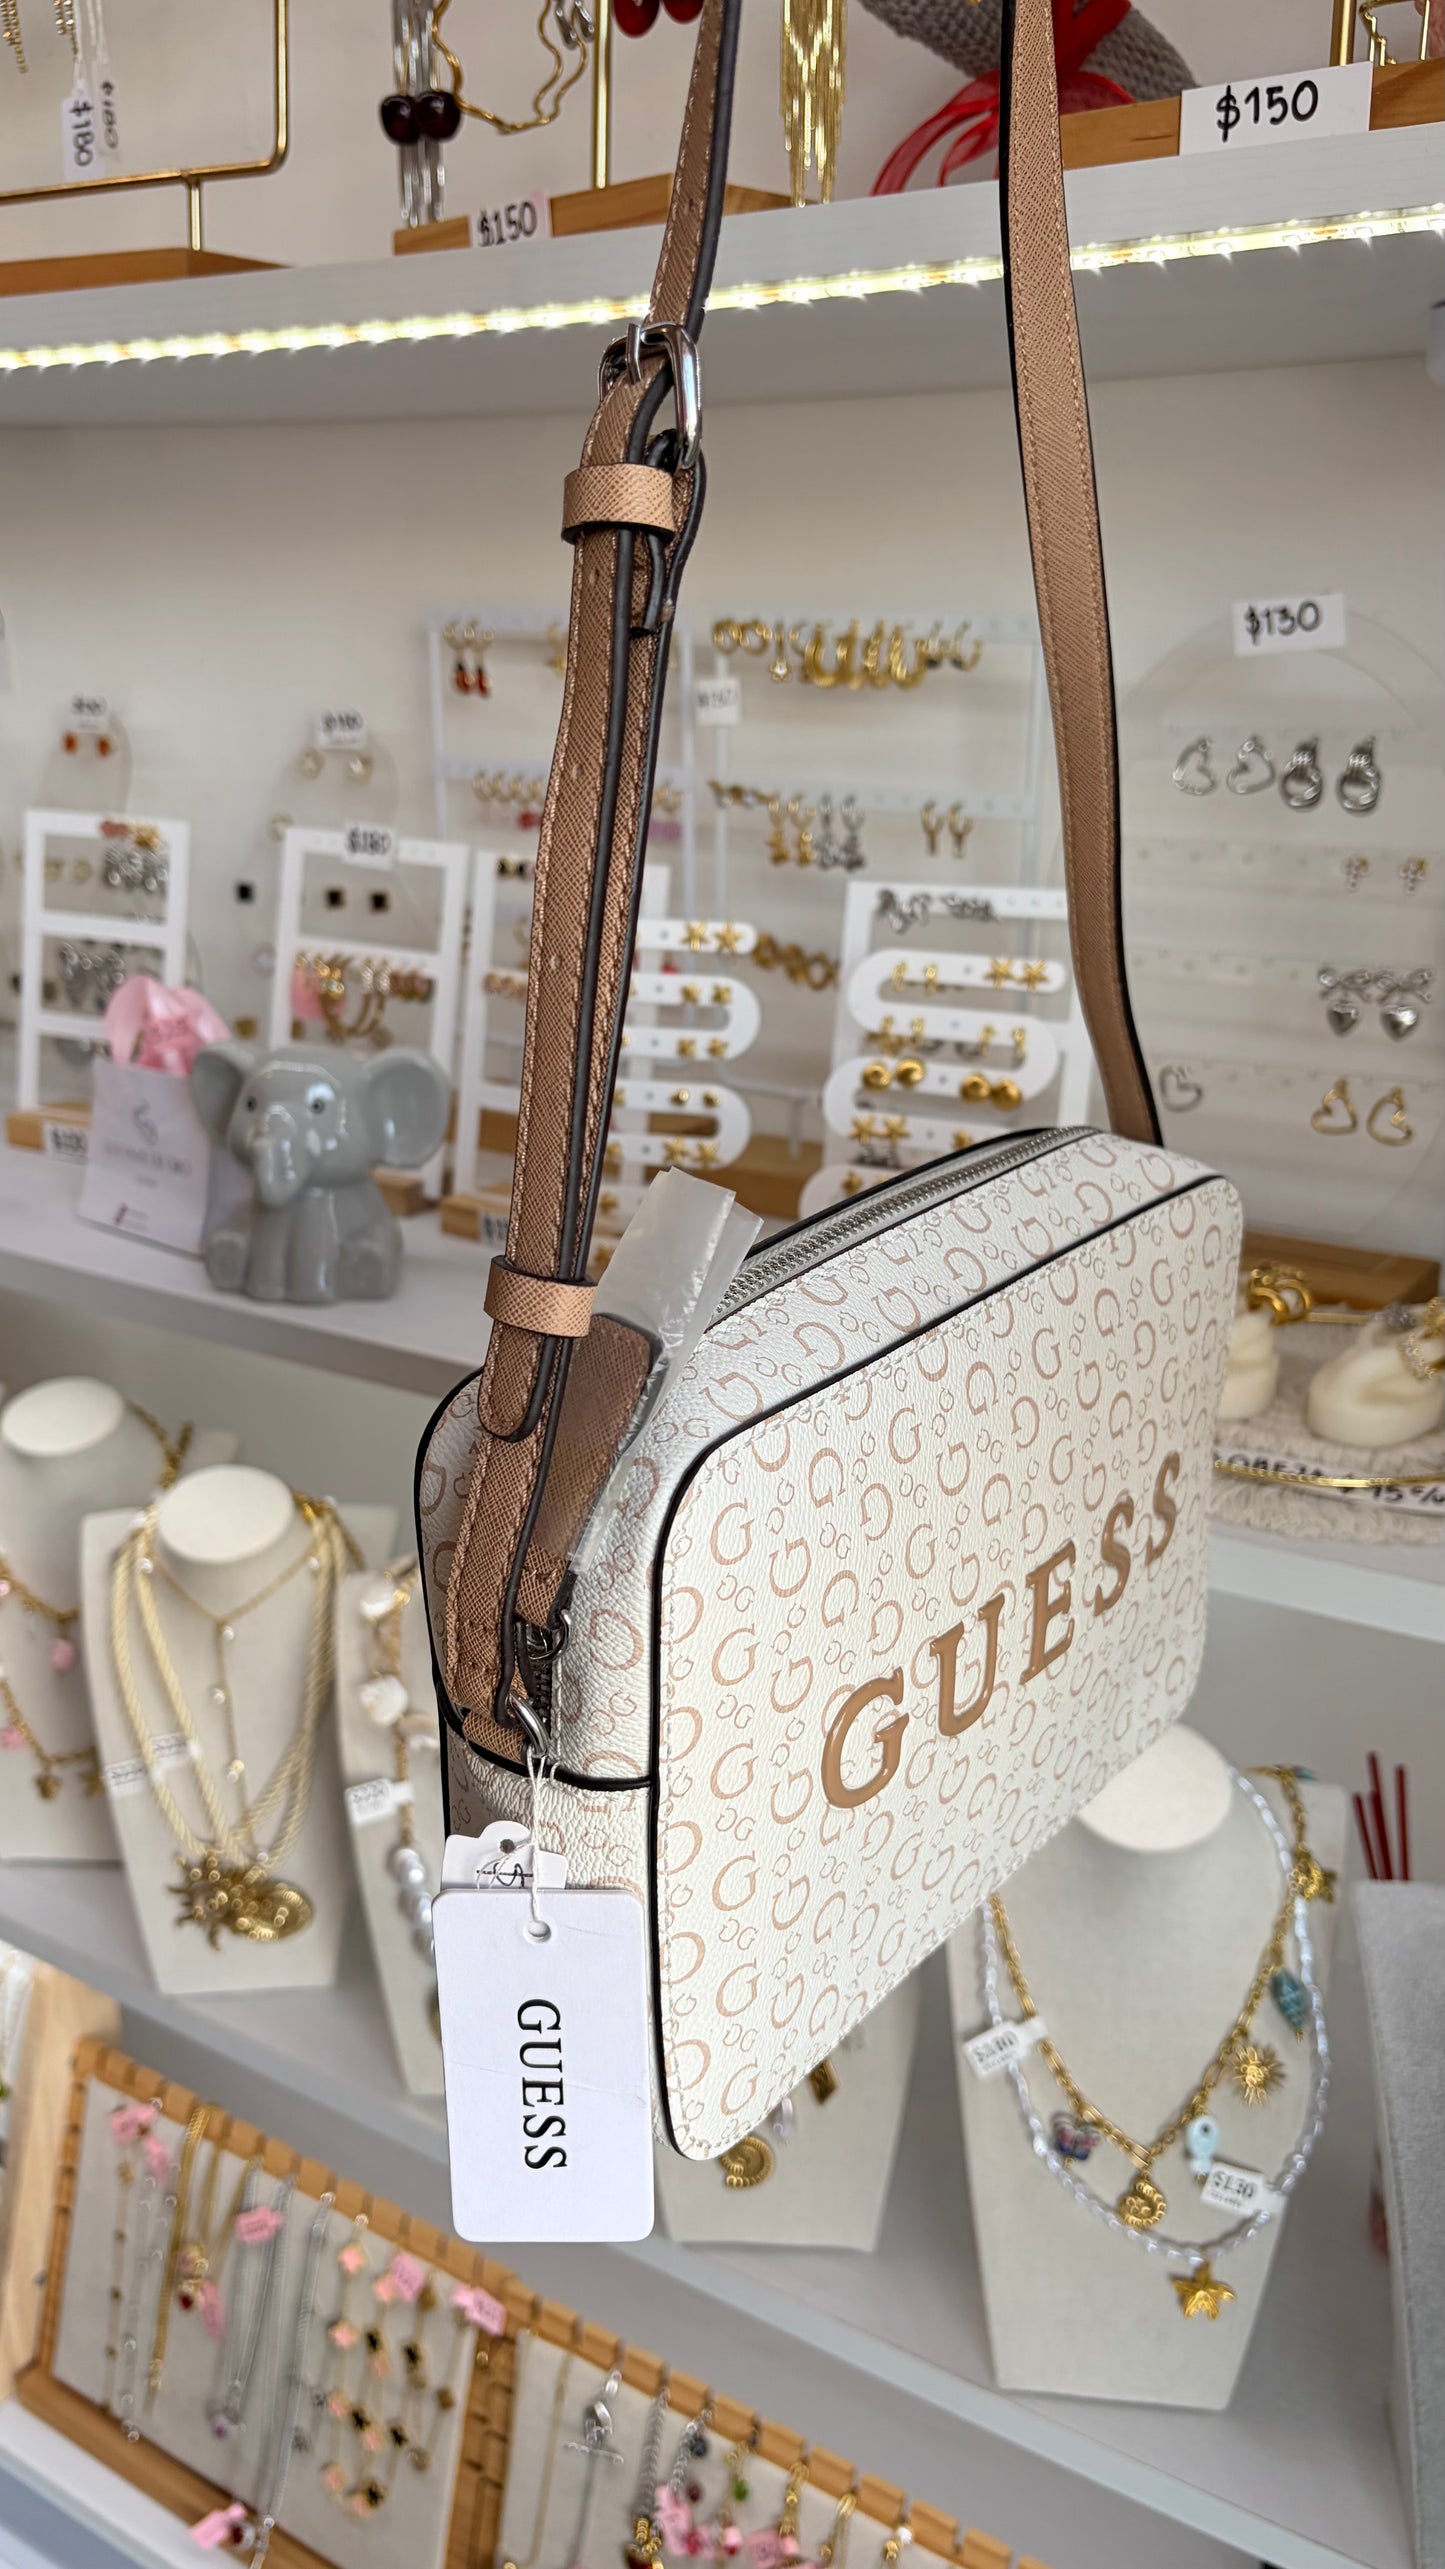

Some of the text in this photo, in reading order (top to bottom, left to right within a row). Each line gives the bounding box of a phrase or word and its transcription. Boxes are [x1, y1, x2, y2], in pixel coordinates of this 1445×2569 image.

[1216, 80, 1319, 143] $150
[478, 202, 538, 248] $150
[1244, 601, 1322, 646] $130
[821, 1451, 1180, 1808] GUESS
[517, 1998, 568, 2170] GUESS
